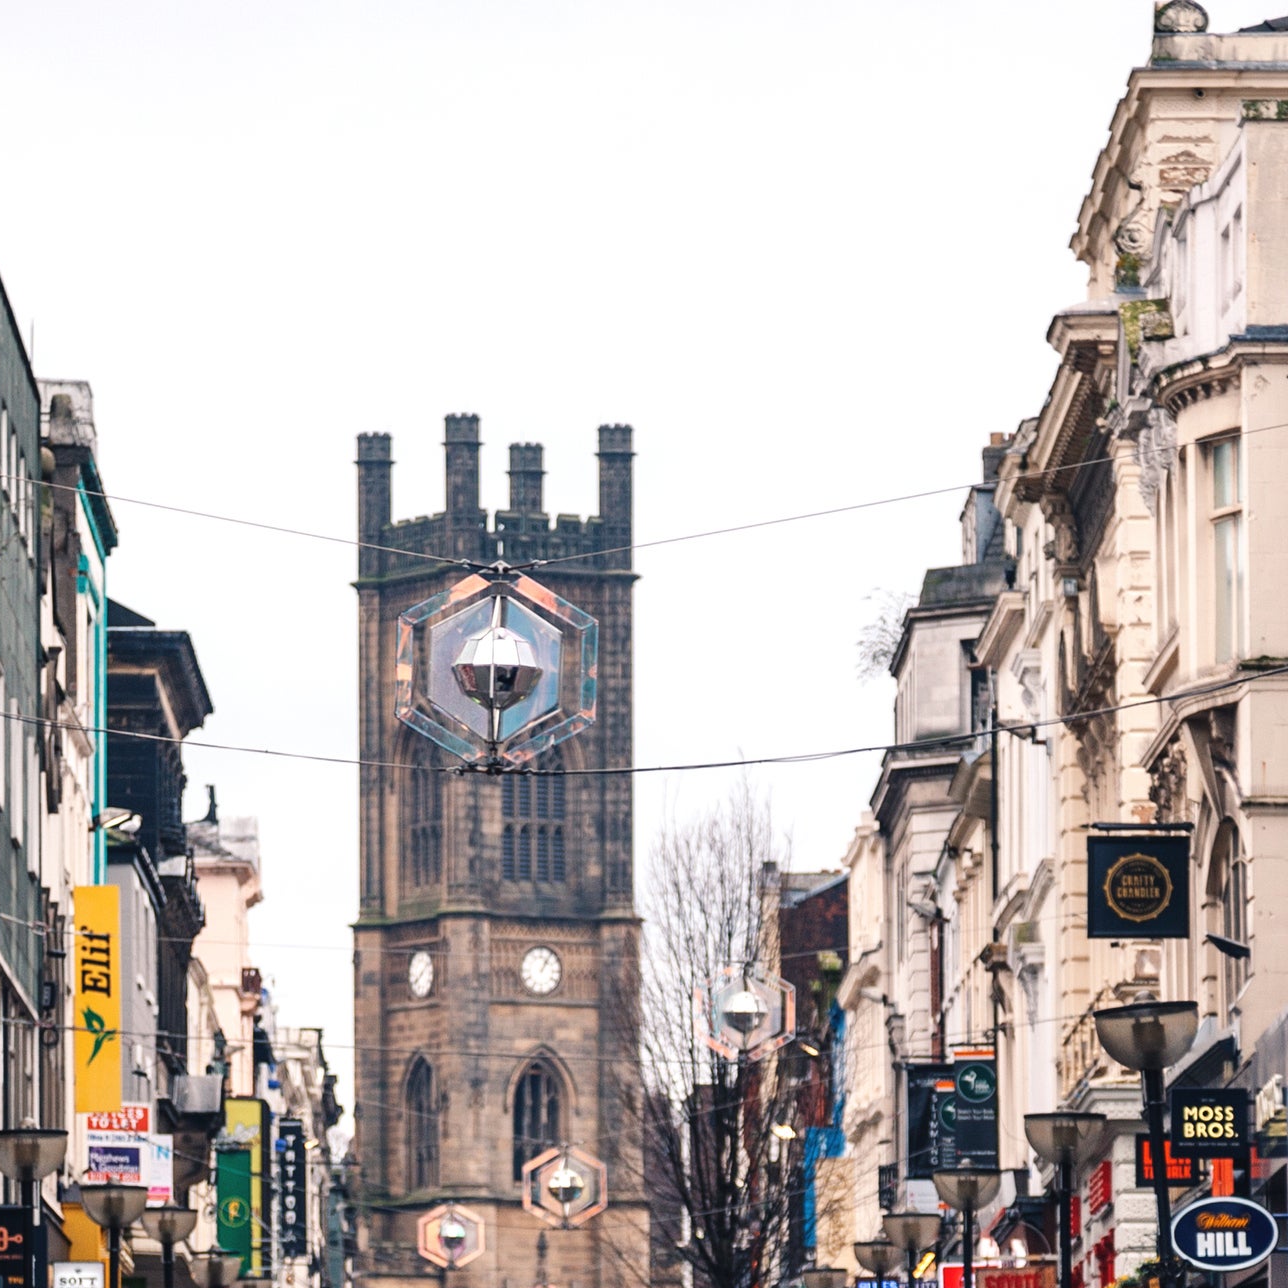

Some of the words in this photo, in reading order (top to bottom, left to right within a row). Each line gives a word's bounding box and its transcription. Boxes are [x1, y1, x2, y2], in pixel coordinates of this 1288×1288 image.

[81, 926, 112, 997] Elif
[1183, 1105, 1235, 1121] MOSS
[1183, 1122, 1239, 1139] BROS.
[1196, 1212, 1251, 1231] William
[1196, 1231, 1253, 1258] HILL
